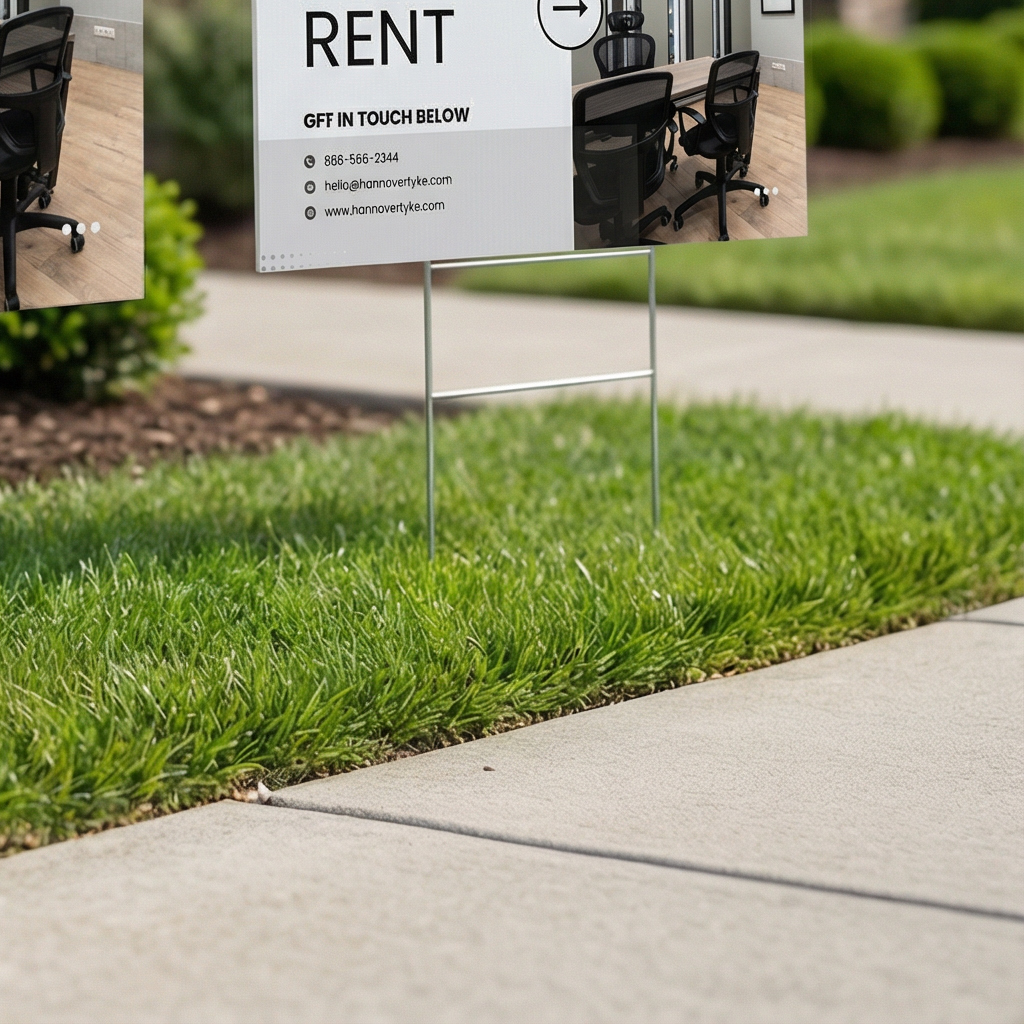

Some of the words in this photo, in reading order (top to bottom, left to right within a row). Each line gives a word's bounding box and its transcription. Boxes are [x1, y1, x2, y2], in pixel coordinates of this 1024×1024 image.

[305, 9, 455, 68] RENT
[337, 111, 354, 128] IN
[356, 109, 413, 127] TOUCH
[416, 106, 470, 125] BELOW
[324, 201, 445, 217] www.hannovertyke.com
